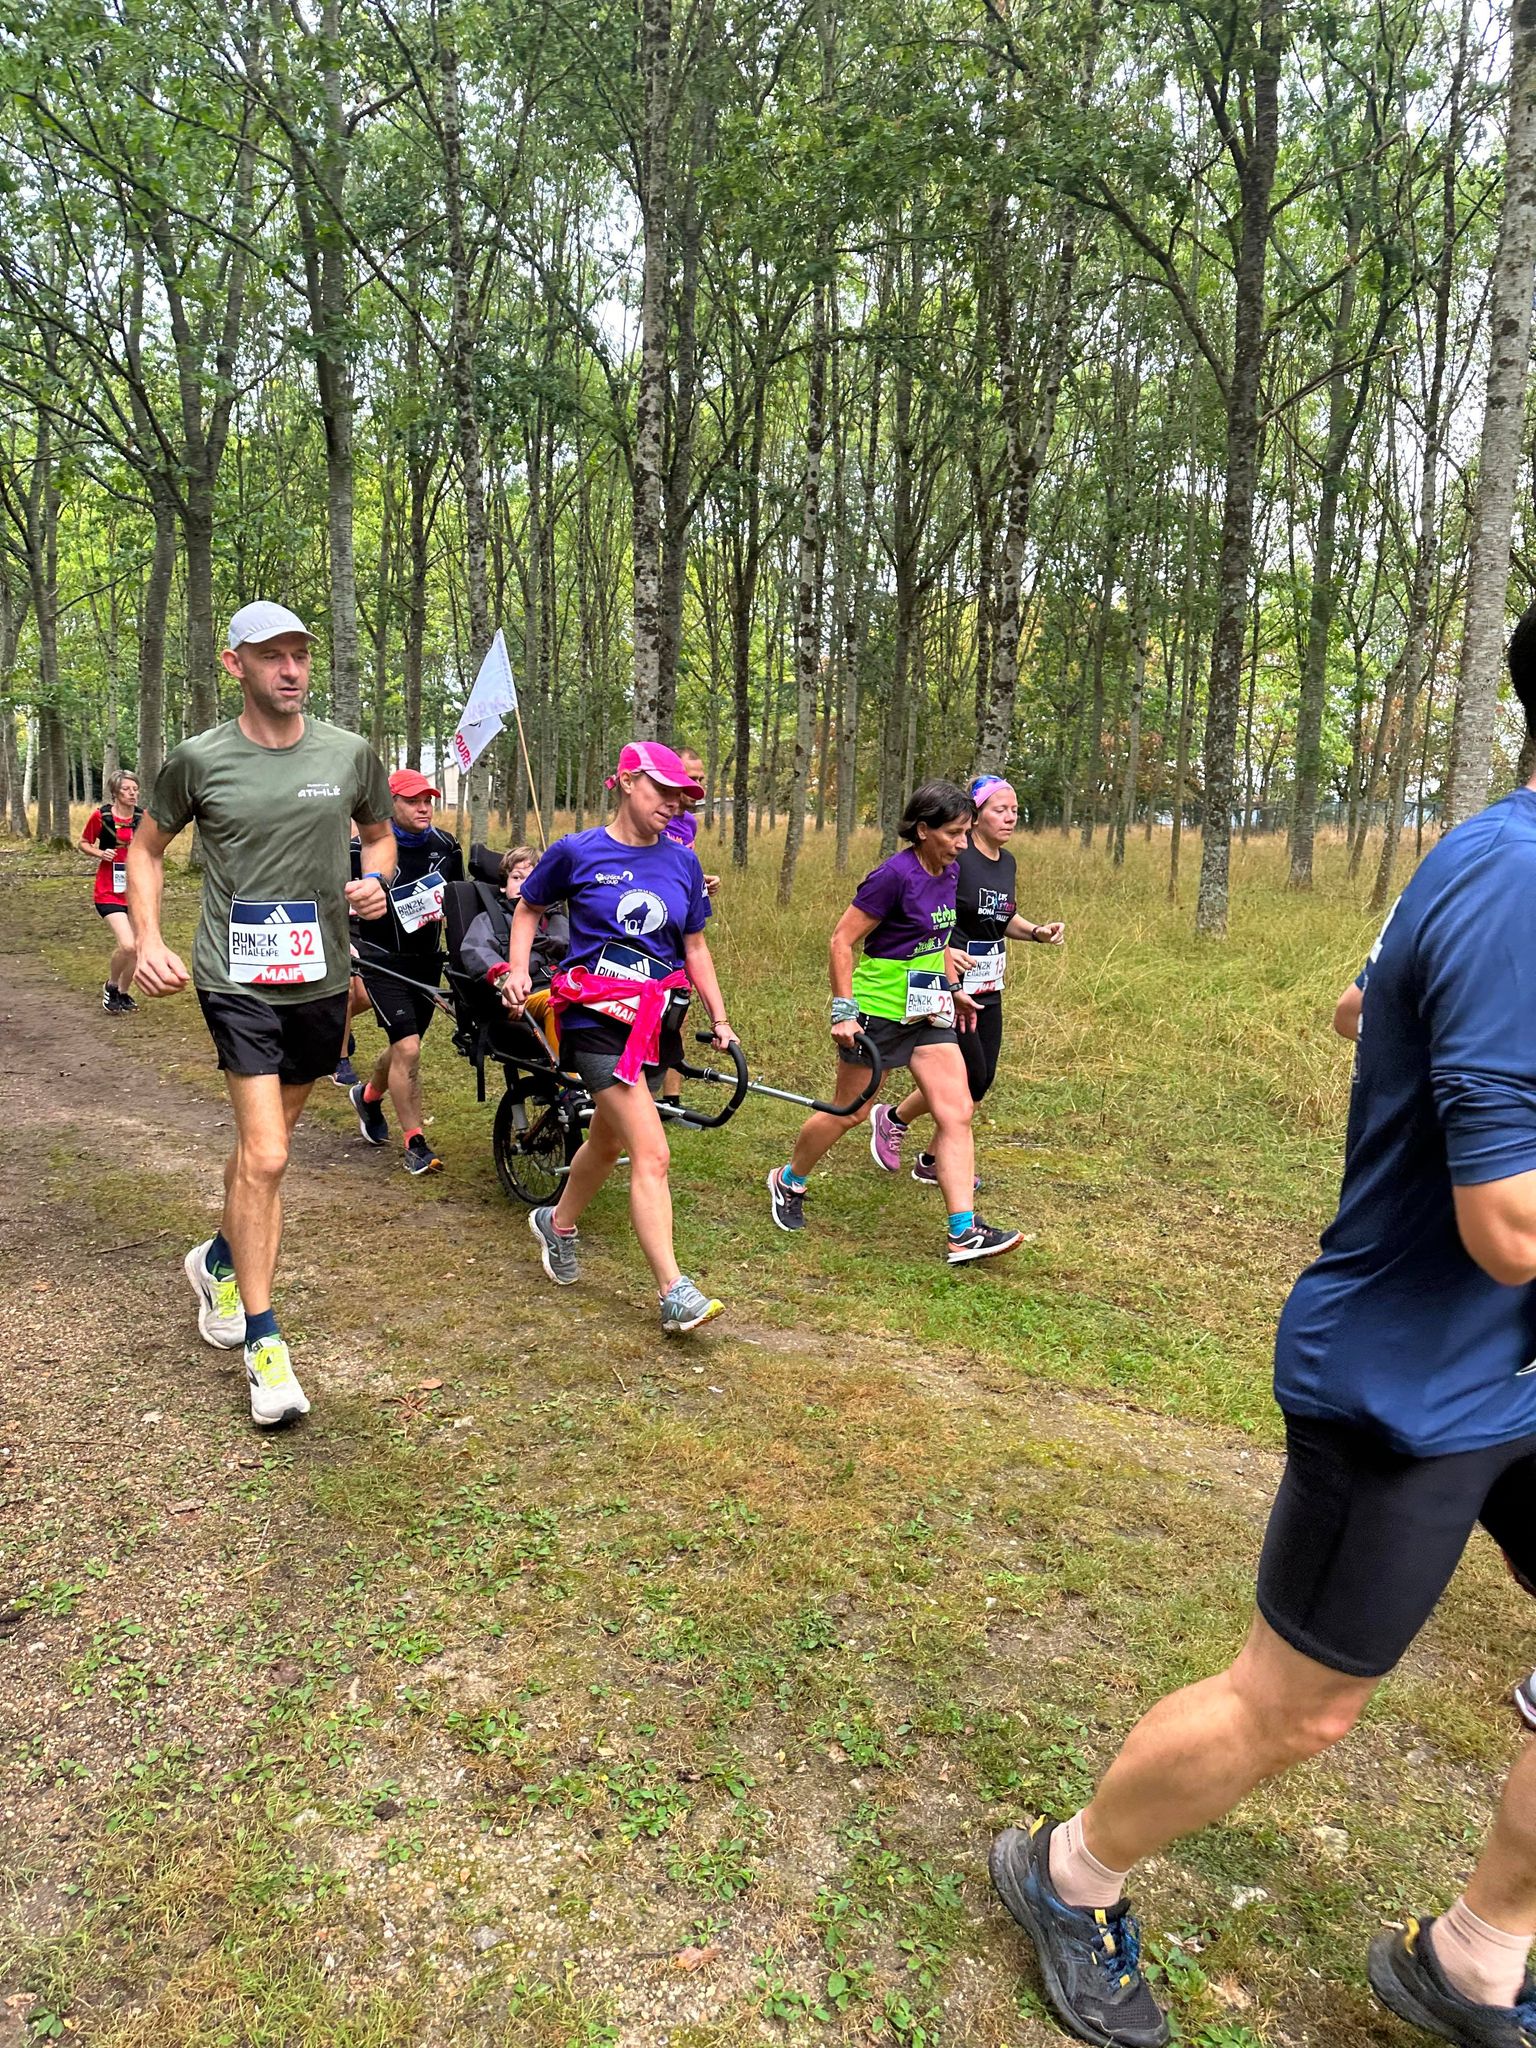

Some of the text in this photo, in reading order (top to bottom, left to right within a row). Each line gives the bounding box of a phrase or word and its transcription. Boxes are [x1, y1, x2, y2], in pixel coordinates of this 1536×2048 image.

[232, 931, 278, 948] RUN2K
[289, 929, 315, 957] 32
[261, 967, 304, 981] MAIF
